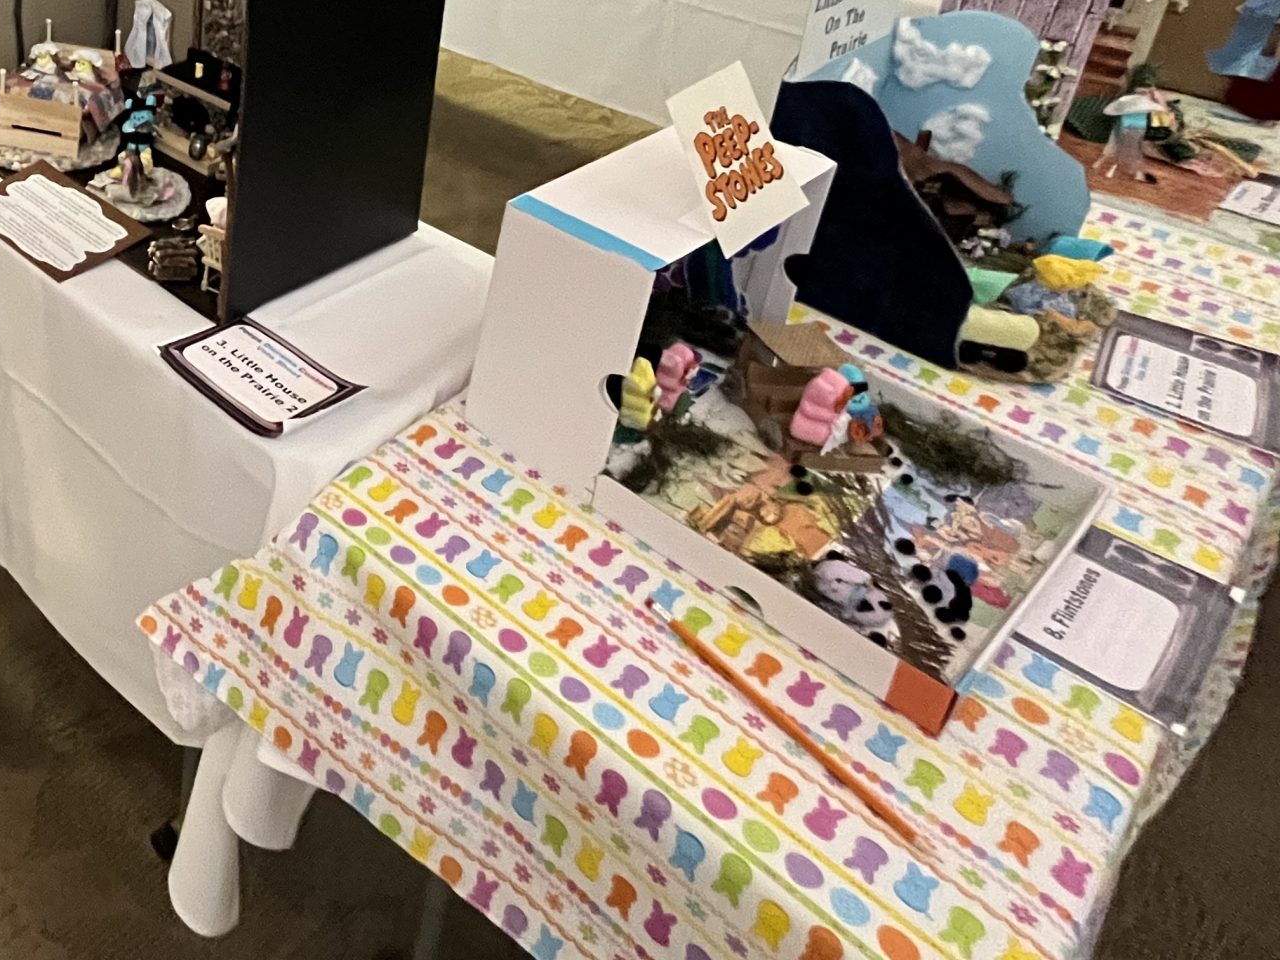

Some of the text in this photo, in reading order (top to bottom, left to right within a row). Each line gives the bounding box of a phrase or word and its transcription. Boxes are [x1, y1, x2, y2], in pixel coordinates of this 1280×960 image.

[825, 8, 865, 35] On The
[829, 31, 868, 59] Prairie
[705, 142, 784, 222] STONES
[201, 345, 217, 356] on
[219, 357, 240, 373] the
[241, 373, 284, 406] Prairie
[216, 340, 308, 405] 3. Little House
[1043, 568, 1101, 640] 8. Flintstones
